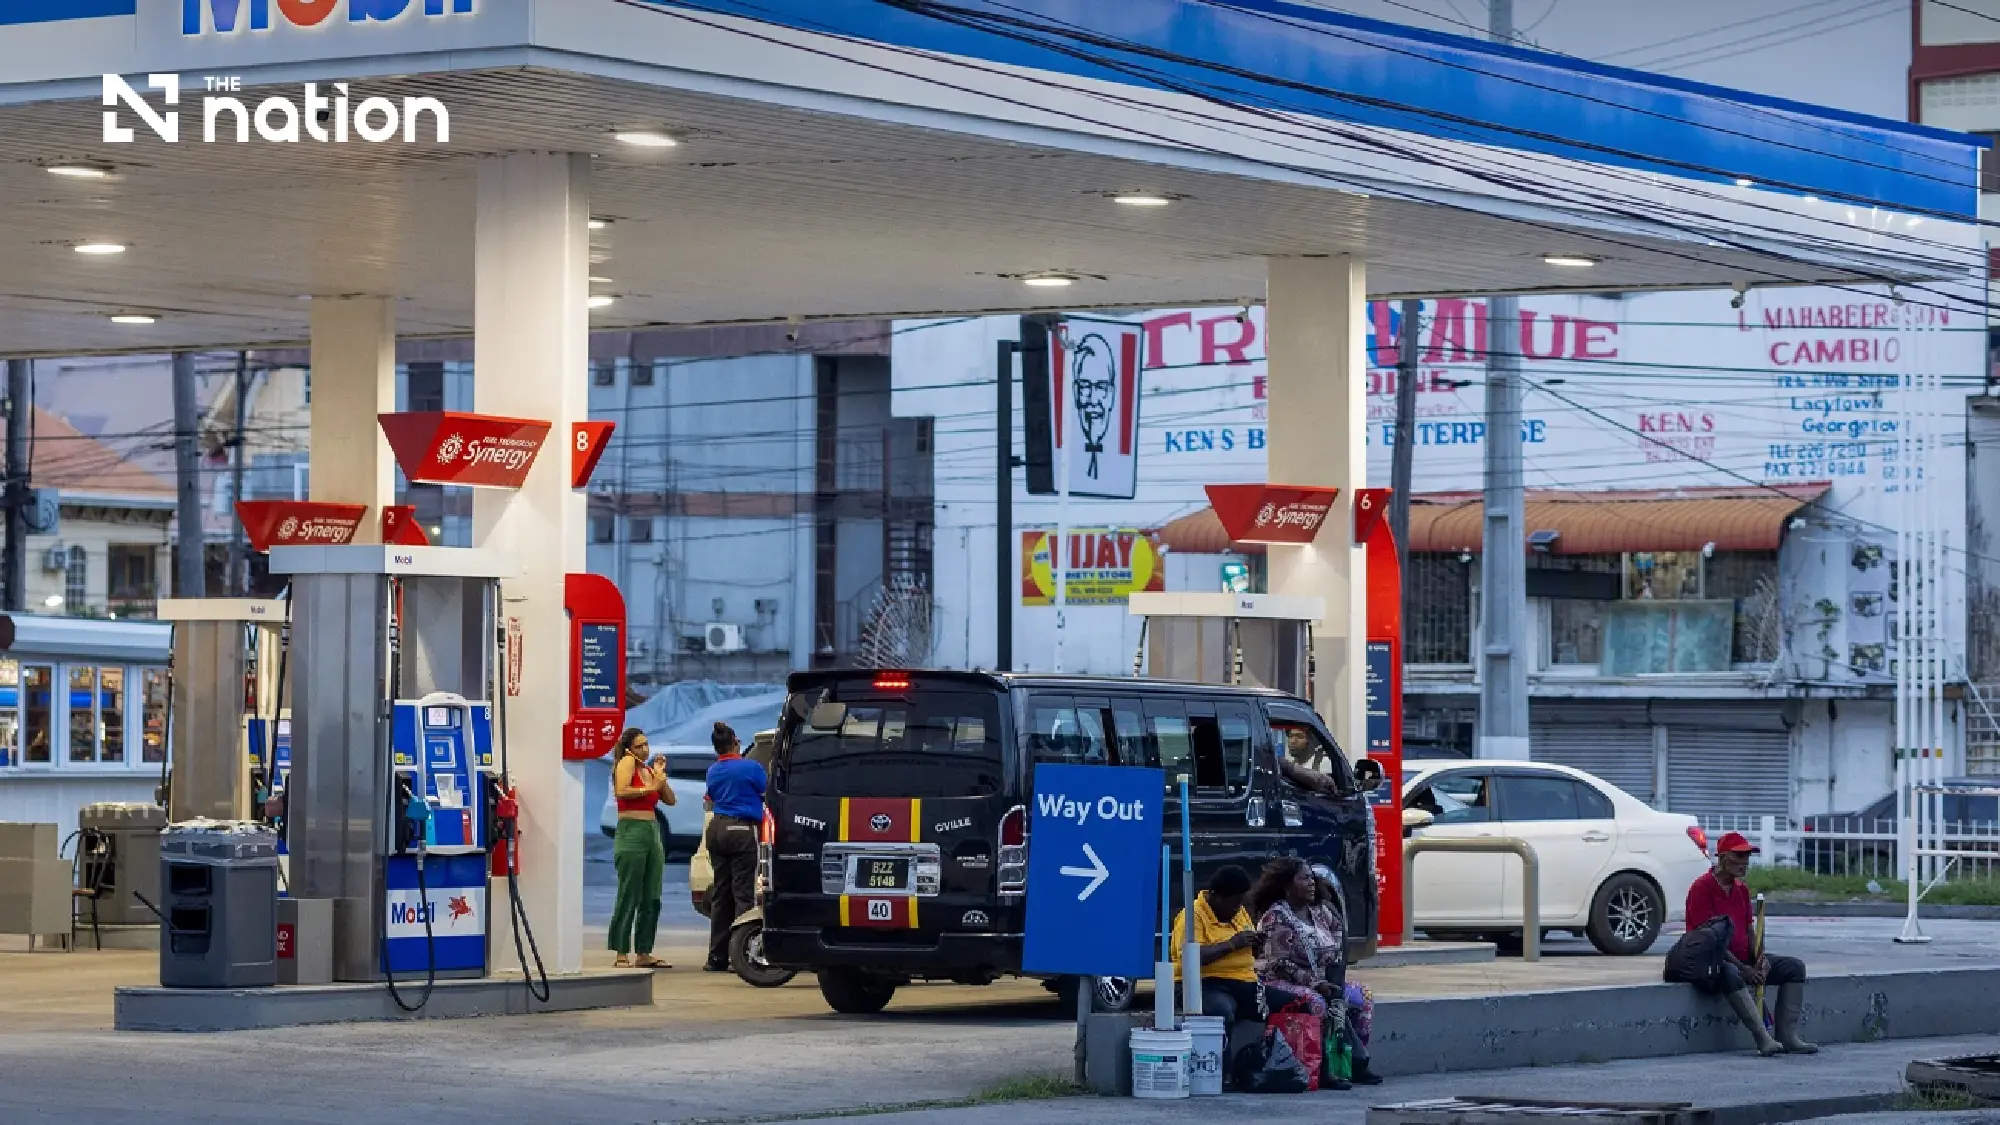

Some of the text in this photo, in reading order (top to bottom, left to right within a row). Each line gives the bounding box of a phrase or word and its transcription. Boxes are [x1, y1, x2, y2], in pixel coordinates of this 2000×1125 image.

[1142, 312, 1267, 368] TR
[1770, 337, 1899, 366] CAMBIO
[576, 430, 588, 451] 8
[1382, 419, 1546, 446] ETERPE
[463, 440, 532, 470] Synergy
[1361, 494, 1371, 510] 6
[388, 512, 395, 524] 2
[1274, 506, 1324, 530] Synergy
[298, 521, 352, 542] Synergy
[394, 555, 413, 565] Mobil
[1037, 793, 1144, 825] Way Out
[794, 814, 827, 831] KITTY
[934, 816, 972, 833] GVILLE
[391, 902, 435, 924] Mobil
[871, 902, 889, 918] 40
